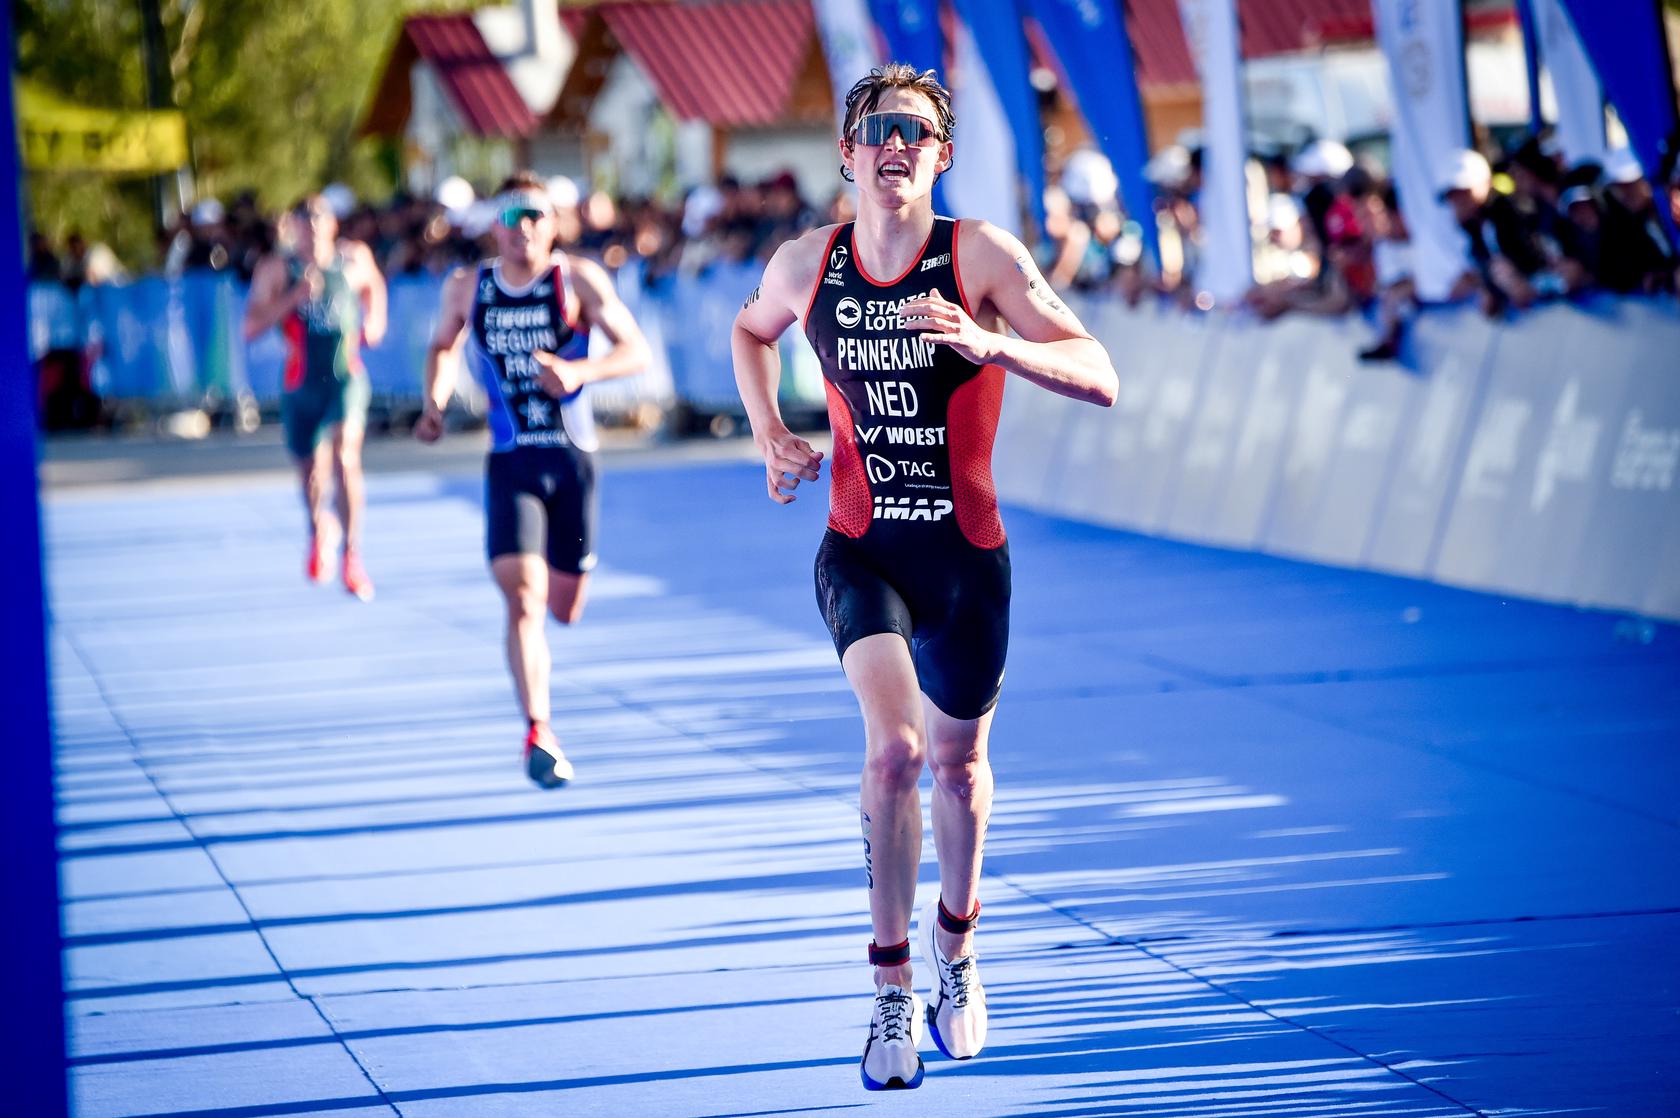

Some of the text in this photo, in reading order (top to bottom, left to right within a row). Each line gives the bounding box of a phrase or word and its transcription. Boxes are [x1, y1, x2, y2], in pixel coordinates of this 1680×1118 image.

[486, 327, 558, 355] SEGUIN
[837, 336, 936, 371] PENNEKAMP
[864, 380, 919, 418] NED
[885, 426, 946, 446] WOEST
[897, 460, 936, 477] TAG
